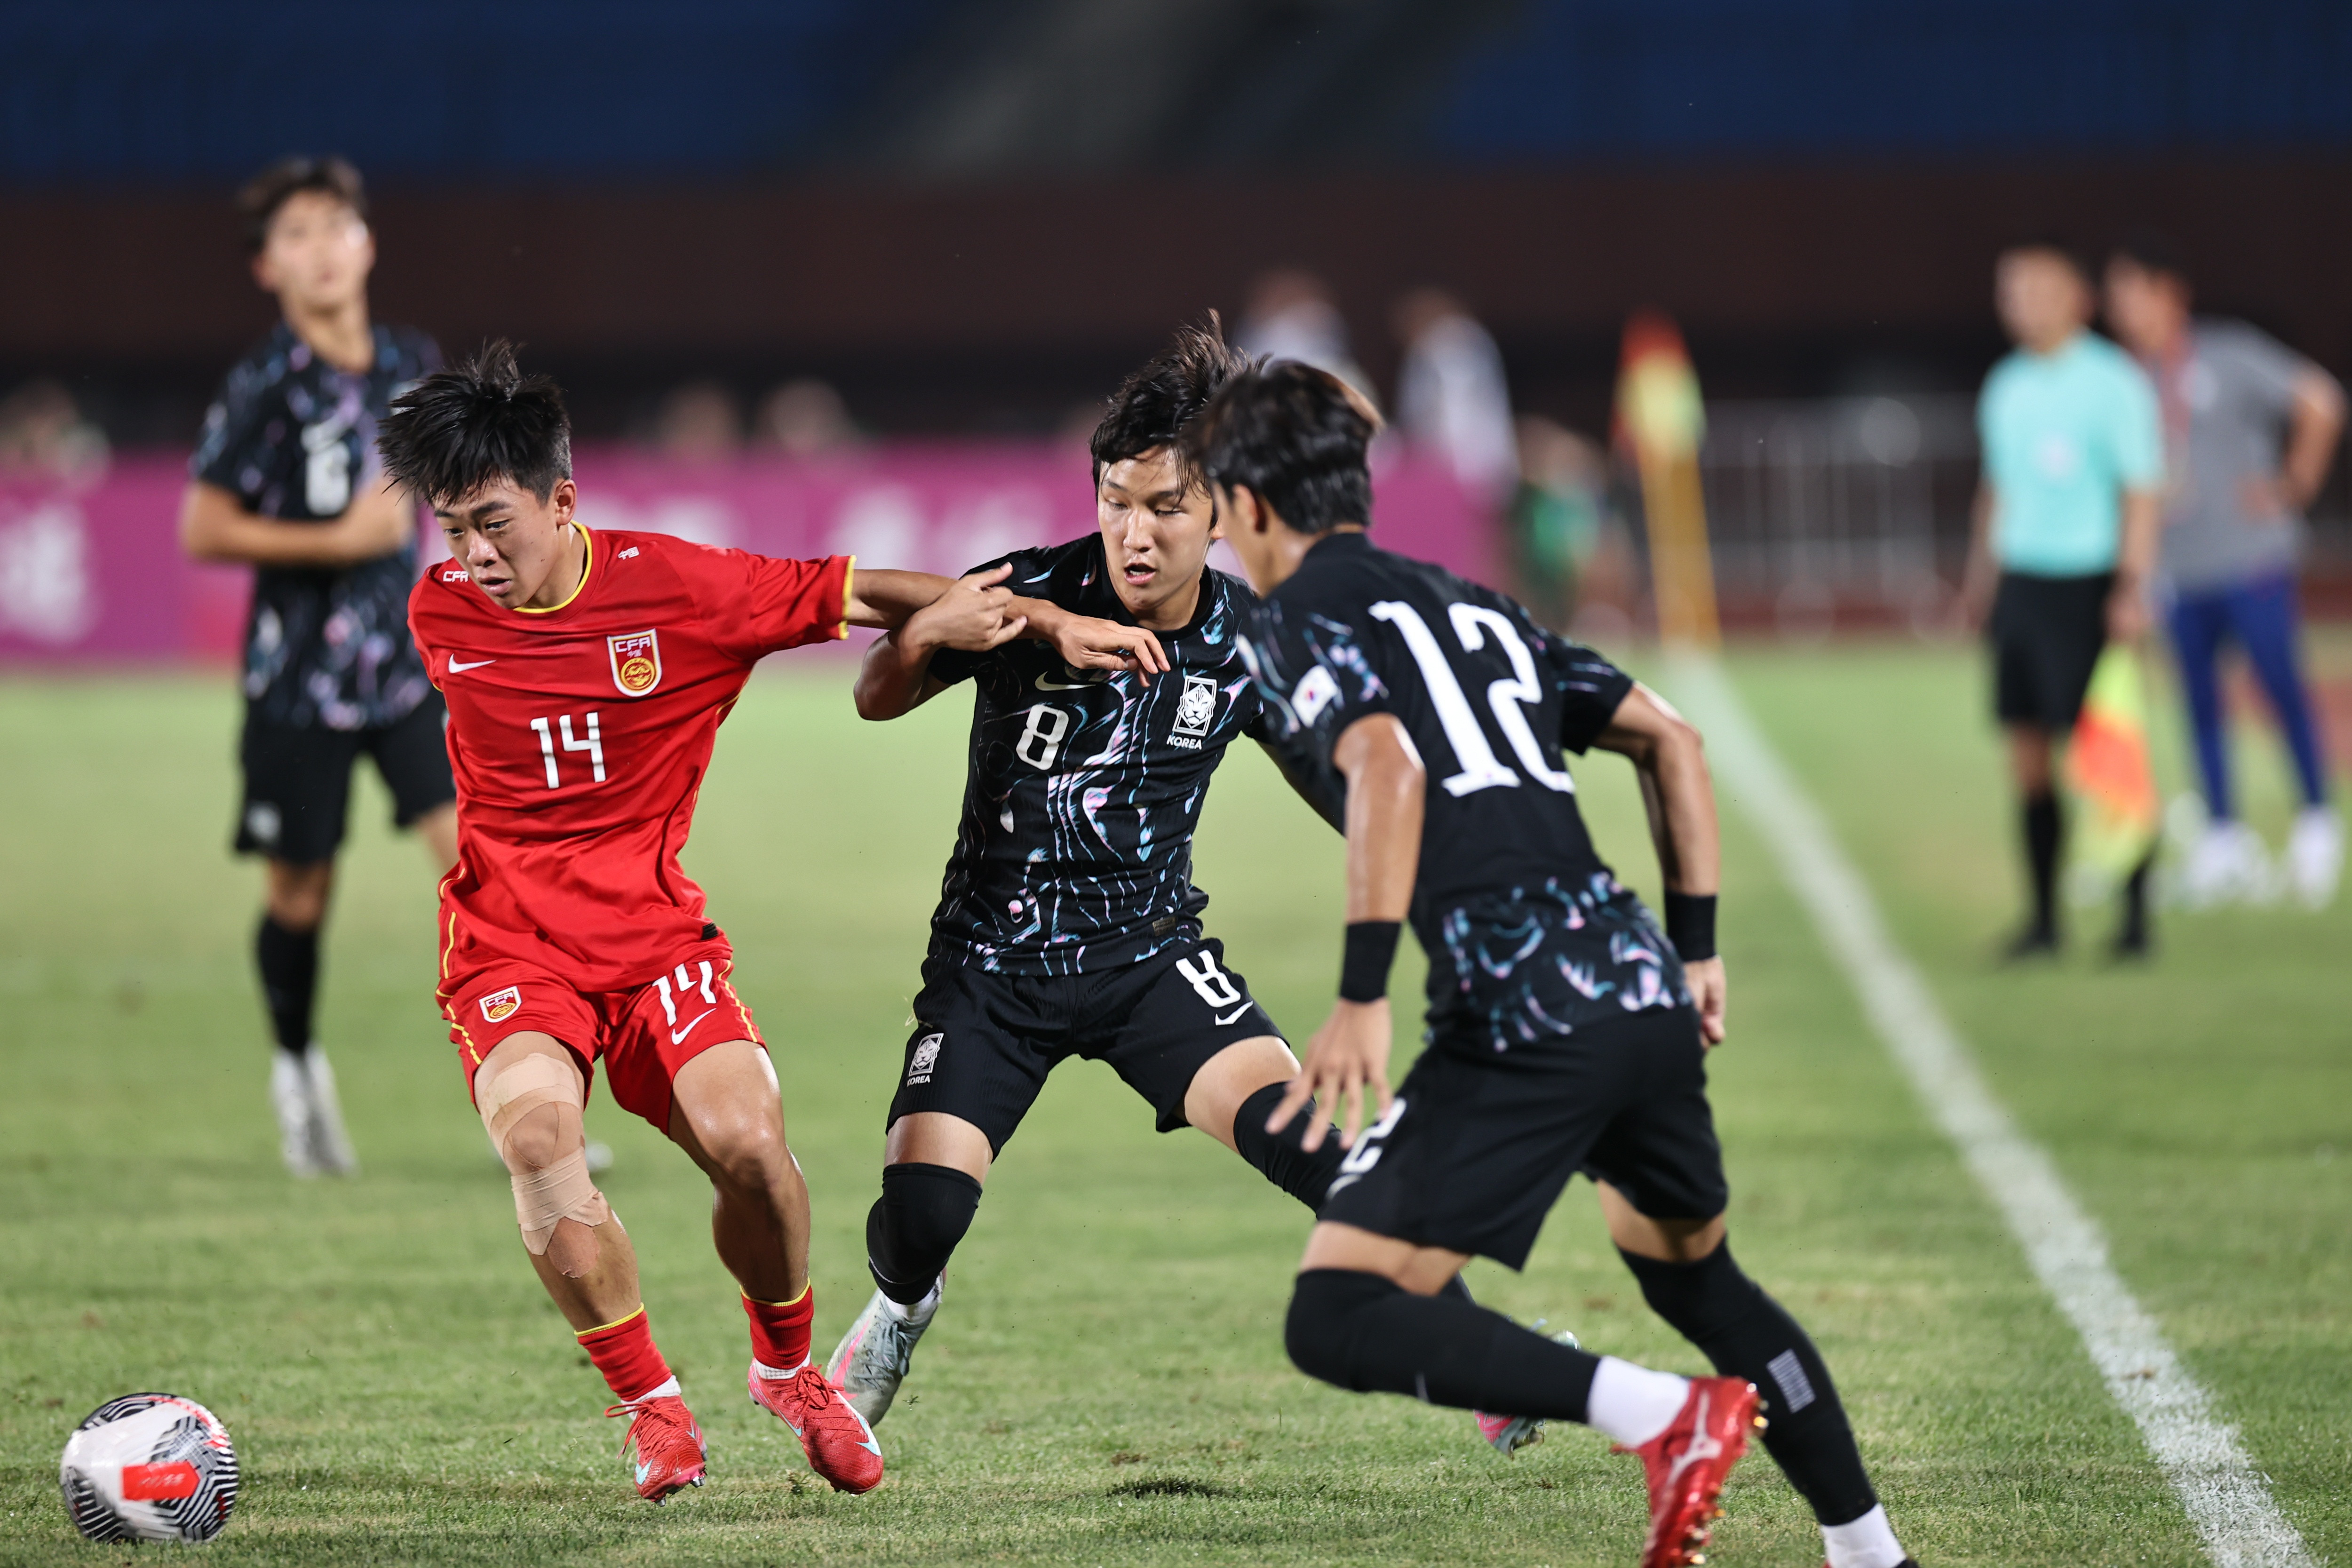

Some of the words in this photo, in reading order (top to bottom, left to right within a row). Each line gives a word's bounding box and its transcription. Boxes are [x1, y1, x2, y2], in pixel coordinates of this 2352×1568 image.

[443, 570, 469, 583] CFA
[614, 636, 651, 653] CFA
[1368, 600, 1575, 797] 12
[530, 712, 606, 789] 14
[1016, 705, 1069, 771] 8
[1166, 734, 1202, 750] KOREA
[652, 960, 717, 1027] 14
[1176, 949, 1241, 1008] 8
[485, 992, 514, 1007] CFA
[907, 1075, 930, 1087] KOREA
